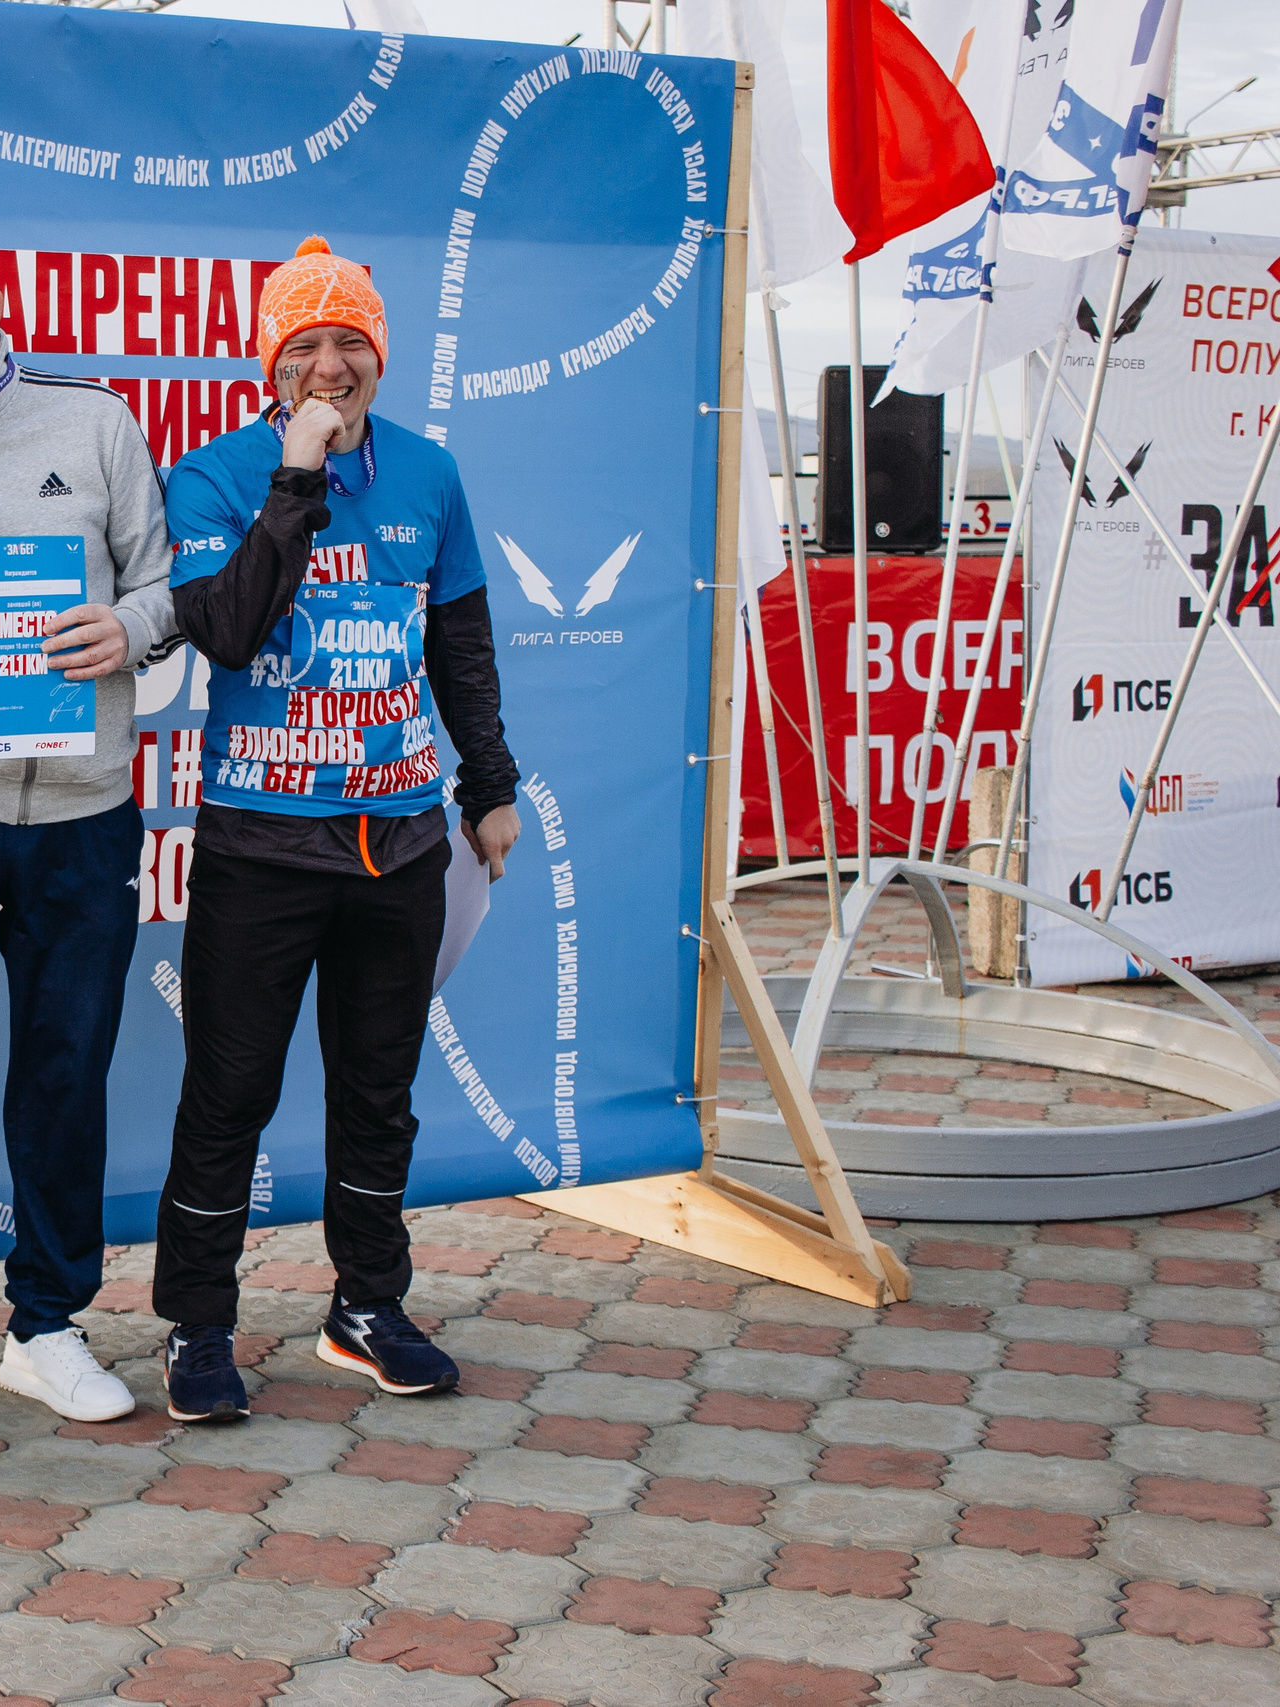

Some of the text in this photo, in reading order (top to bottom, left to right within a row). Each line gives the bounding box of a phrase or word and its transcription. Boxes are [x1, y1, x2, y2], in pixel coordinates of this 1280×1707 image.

[500, 54, 570, 120] МАГАДАН
[578, 49, 642, 80] ЛИПЕЦК
[644, 67, 695, 134] КЫЗЫЛ
[133, 153, 210, 188] ЗАРАЙСК
[223, 146, 297, 187] ИЖЕВСК
[303, 91, 376, 165] ИРКУТСК
[460, 119, 508, 199] МАЙКОП
[682, 140, 707, 202] КУРСК
[438, 208, 476, 318] МАХАЧКАЛА
[651, 216, 705, 309] КУРИЛЬСК
[560, 303, 656, 378] КРАСНОЯРСК
[1064, 355, 1146, 370] ЛИГА ЕРОЕВ
[428, 333, 458, 409] МОСКВА
[462, 359, 551, 401] КРАСНОДАР
[39, 486, 73, 498] adidas
[1096, 521, 1140, 533] ГЕРОЕВ
[303, 543, 368, 585] ЕЧТА
[318, 590, 338, 598] ПСБ
[318, 619, 404, 654] 40004
[510, 630, 624, 646] ЛИГА ГЕРОЕВ
[286, 680, 420, 728] #ГОРДОСТЬ
[1114, 680, 1174, 712] ПСБ
[35, 741, 70, 750] FONBET
[228, 725, 366, 765] #ЛЮБОВЬ
[845, 729, 1024, 806] ПОЛ
[216, 757, 316, 796] #ЗАБЕГ
[1145, 774, 1182, 817] ЦСП
[150, 960, 184, 1025] МЕНЬ
[521, 772, 581, 1189] ЖНИЙ НОВГОРОД НОВОСИБИРСК ОМСК ОРЕНБУРГ
[513, 1136, 559, 1187] ПСКОВ
